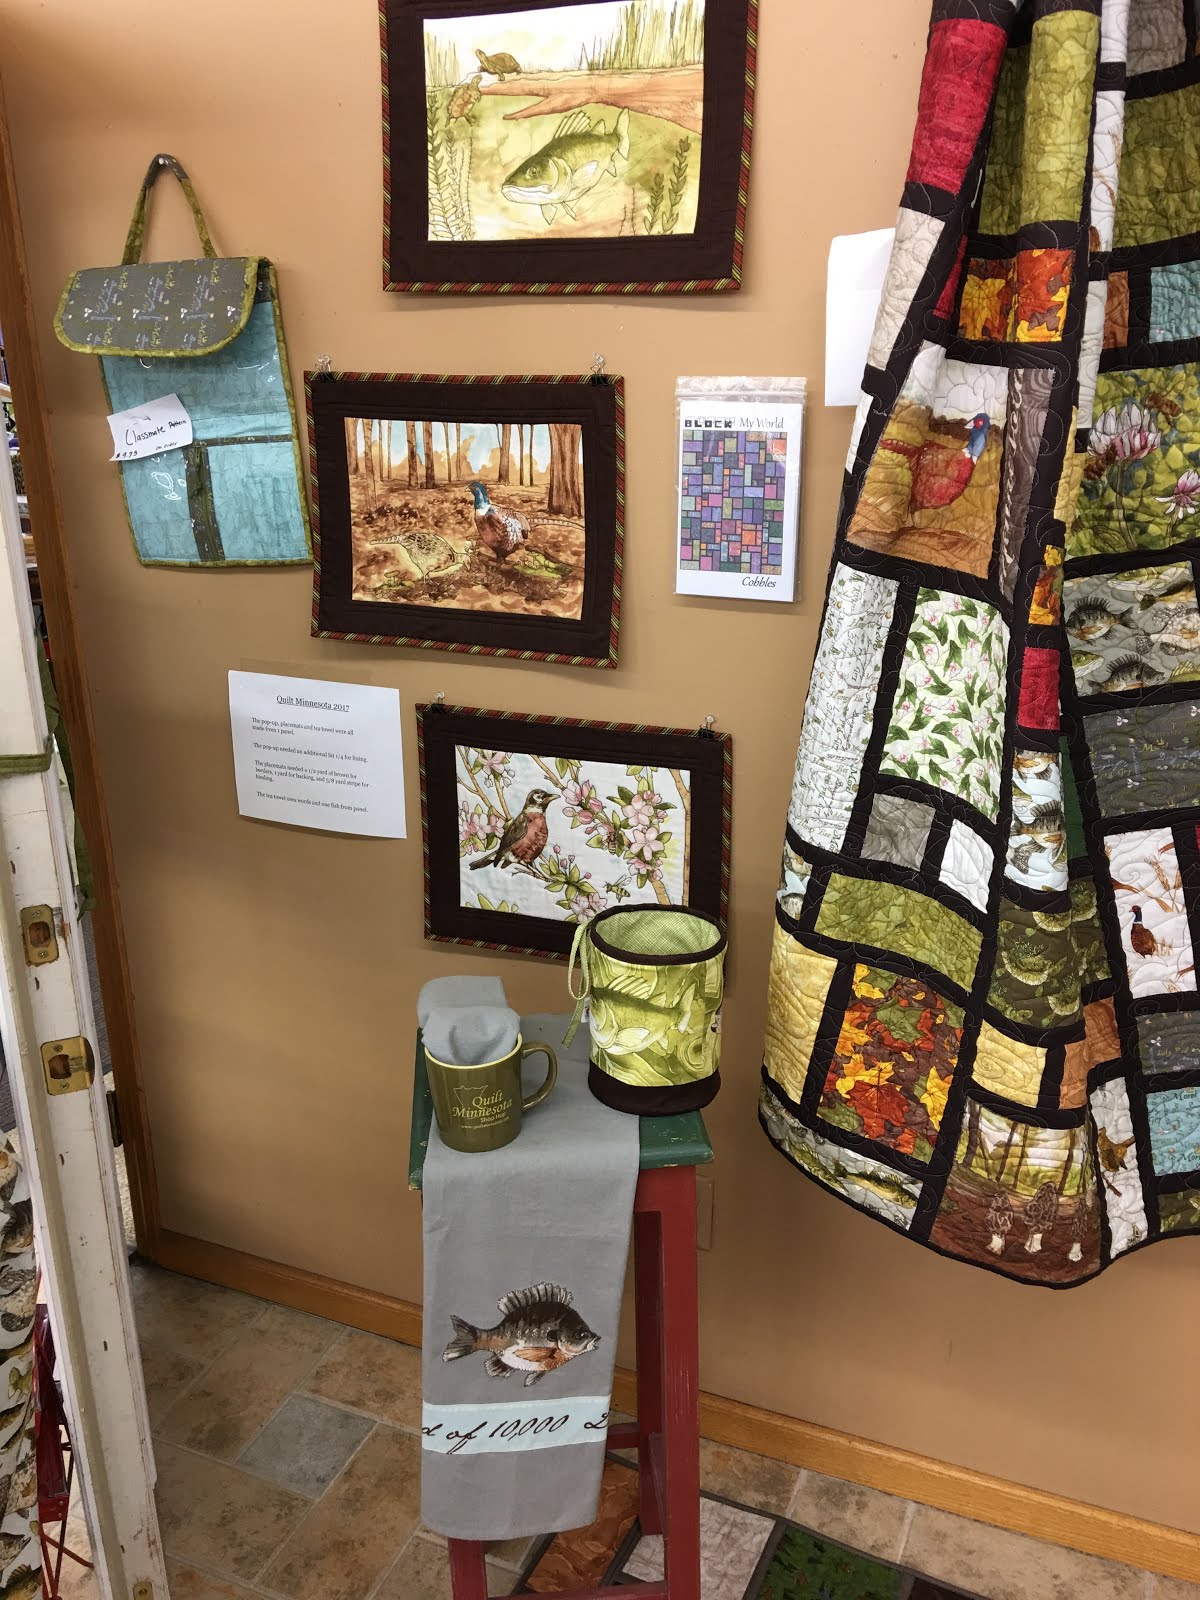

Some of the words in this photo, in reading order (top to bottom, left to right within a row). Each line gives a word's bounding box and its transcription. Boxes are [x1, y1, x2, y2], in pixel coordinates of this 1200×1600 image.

[684, 418, 733, 428] BLOCK
[740, 417, 754, 431] My
[756, 417, 784, 428] World
[126, 426, 166, 446] Classmate
[742, 576, 776, 588] Cobbles
[276, 695, 294, 705] Quilt
[295, 698, 332, 710] Minnesota
[333, 704, 350, 712] 2017
[280, 721, 304, 729] placemats
[255, 767, 273, 775] borders,
[264, 762, 286, 770] placemats
[472, 1090, 504, 1110] Quilt
[452, 1098, 512, 1118] Minnesota
[446, 1420, 488, 1455] of
[488, 1414, 570, 1442] 10,000
